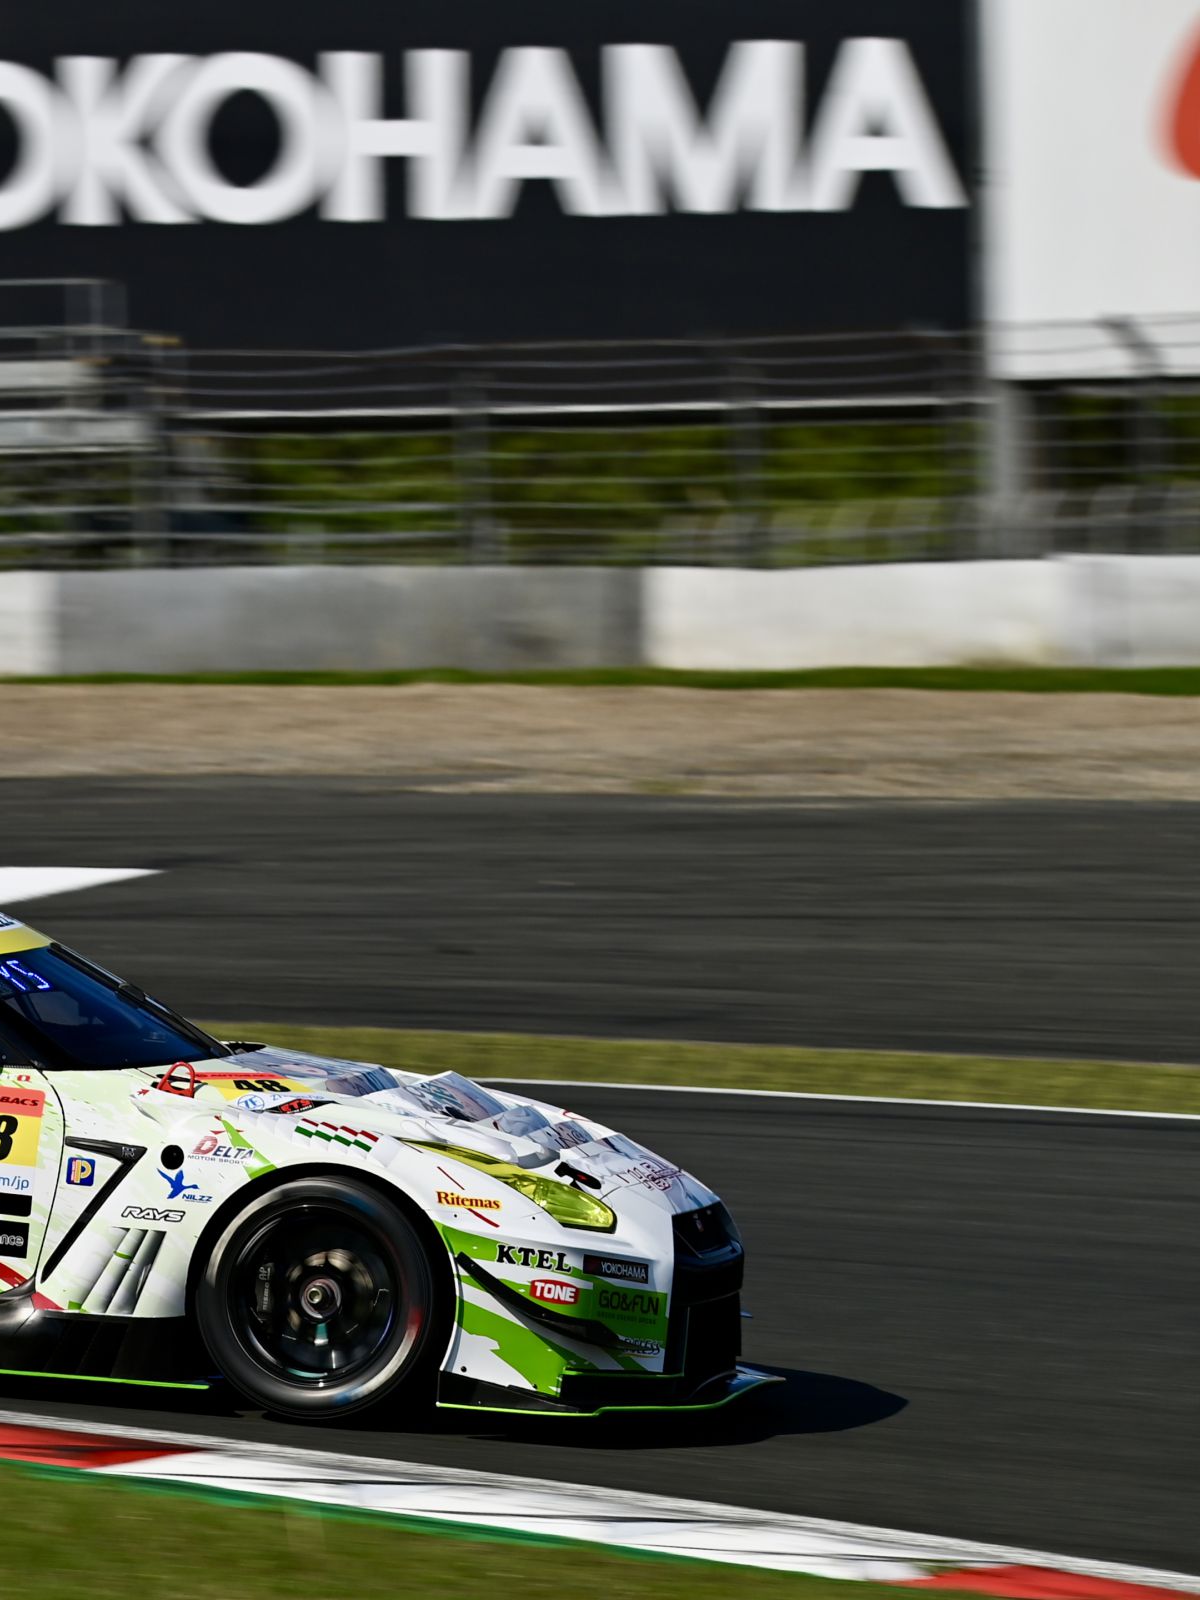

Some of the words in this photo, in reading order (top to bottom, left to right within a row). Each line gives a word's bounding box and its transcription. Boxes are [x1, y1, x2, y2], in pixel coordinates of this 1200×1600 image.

[233, 1079, 290, 1093] 48
[192, 1136, 254, 1159] DELTA
[187, 1154, 216, 1162] MOTOR
[182, 1193, 213, 1202] NILZZ
[436, 1191, 500, 1210] Ritemas
[121, 1206, 185, 1222] RAYS
[496, 1244, 572, 1273] KTEL
[601, 1261, 646, 1279] YOKOHAMA
[534, 1281, 576, 1303] TONE
[599, 1290, 659, 1316] GO&FUN
